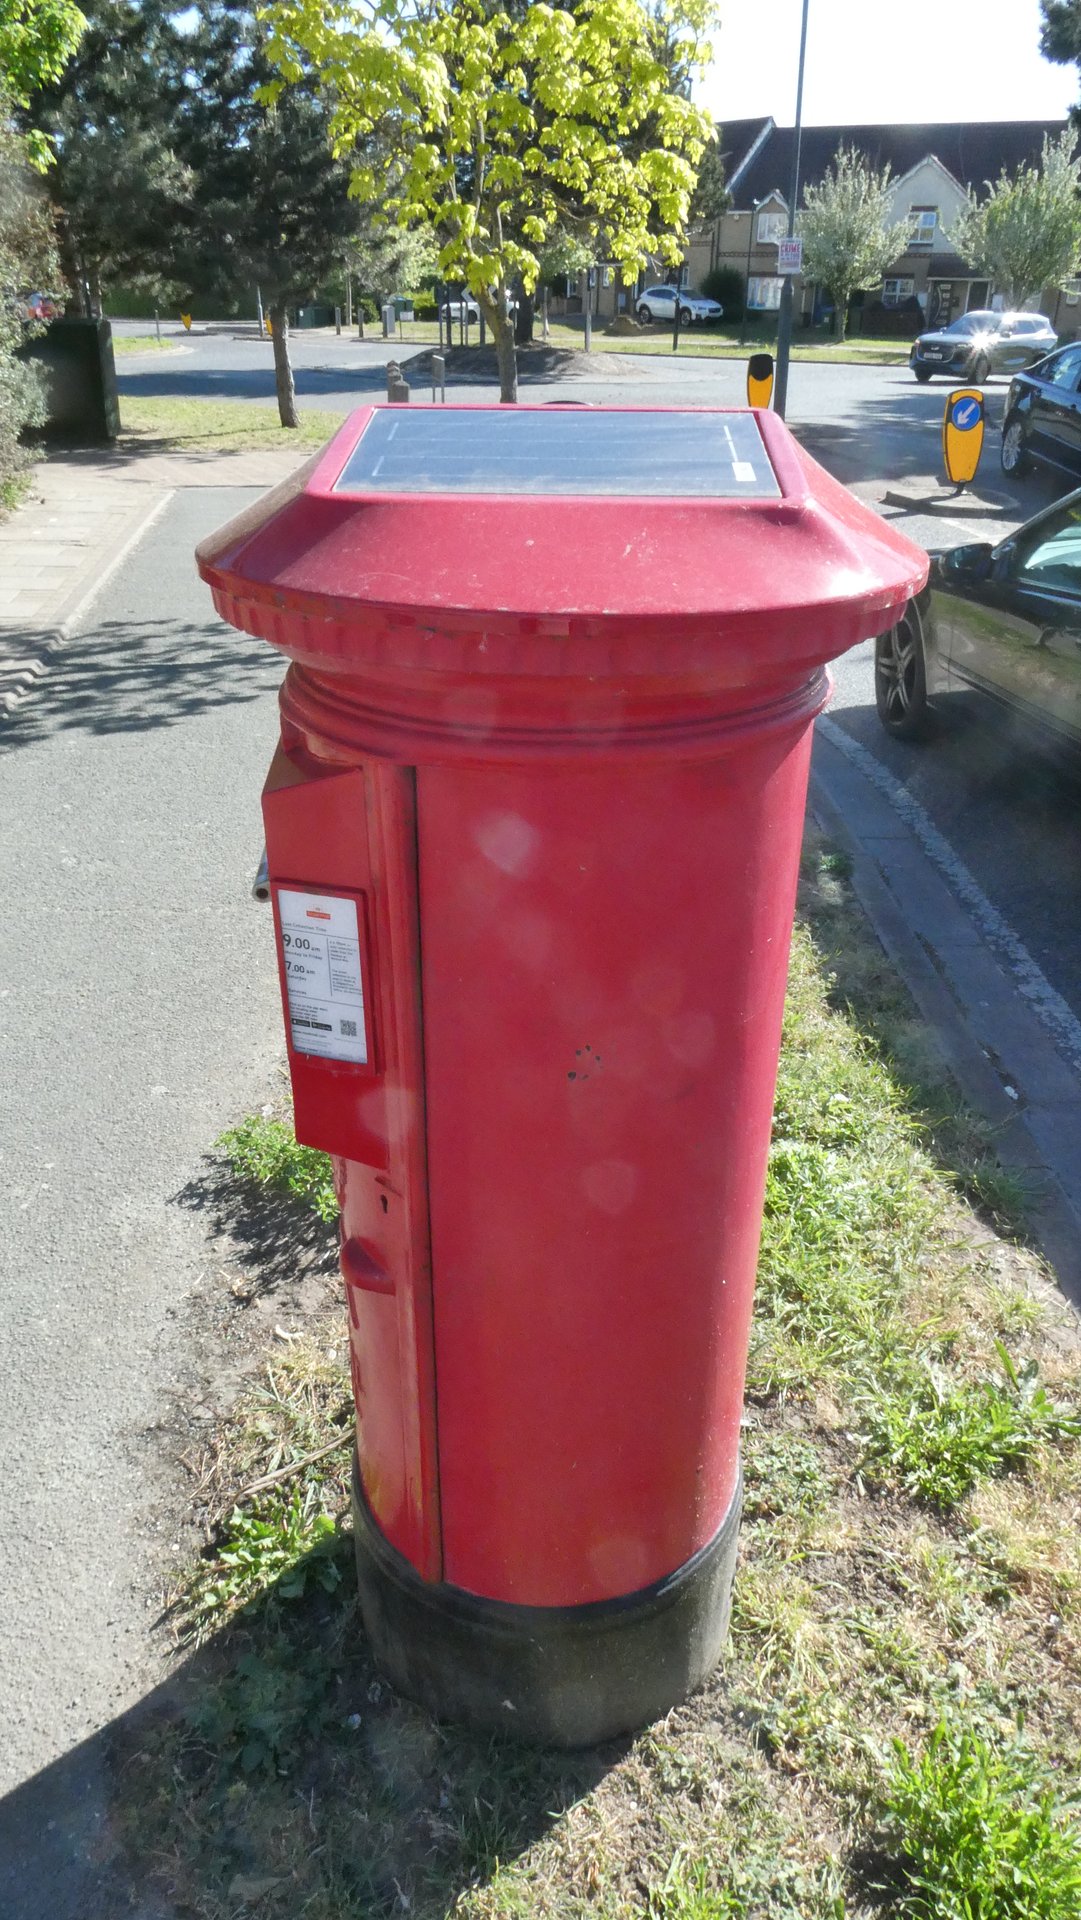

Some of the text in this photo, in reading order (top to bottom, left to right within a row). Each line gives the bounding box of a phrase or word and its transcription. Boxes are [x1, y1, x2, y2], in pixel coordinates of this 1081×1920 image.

[781, 243, 800, 253] CRIME
[283, 934, 310, 949] 9.00
[285, 961, 304, 973] 7.00
